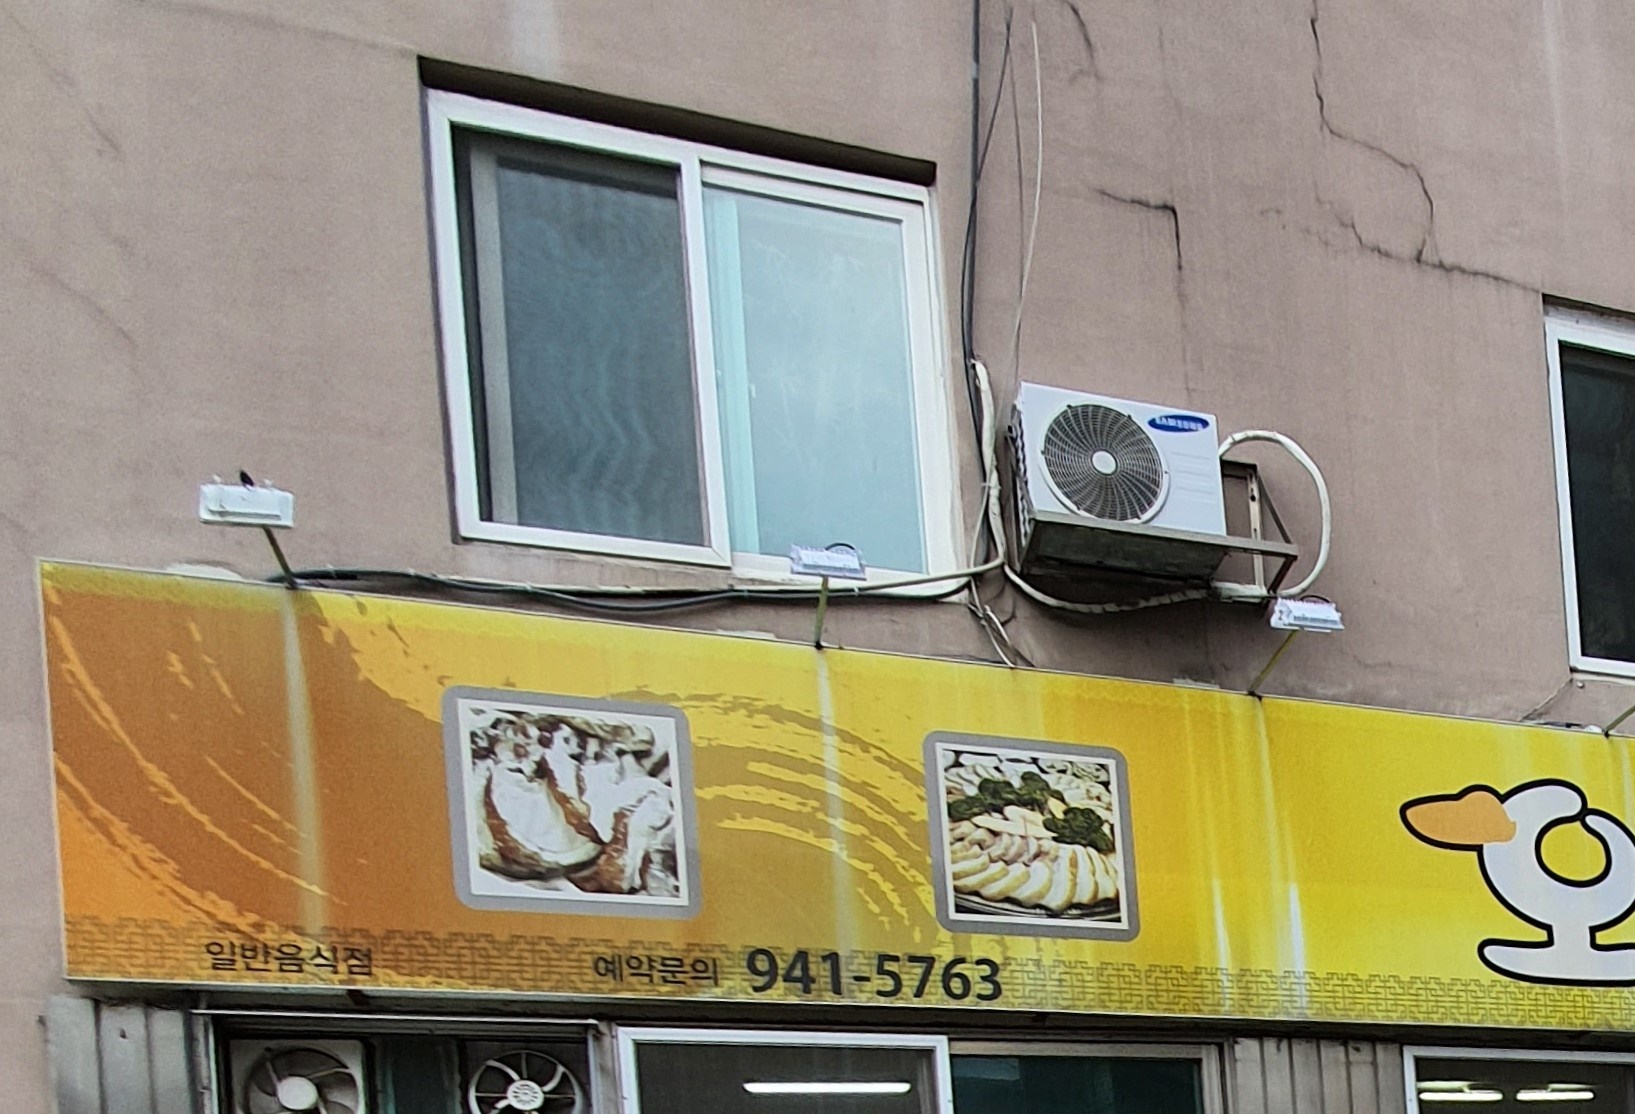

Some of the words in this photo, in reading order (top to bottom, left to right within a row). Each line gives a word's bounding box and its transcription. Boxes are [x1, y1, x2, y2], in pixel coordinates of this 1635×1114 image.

[204, 940, 373, 977] 일반음식점
[593, 953, 721, 986] 예약문의
[746, 947, 1003, 1001] 941-5763
